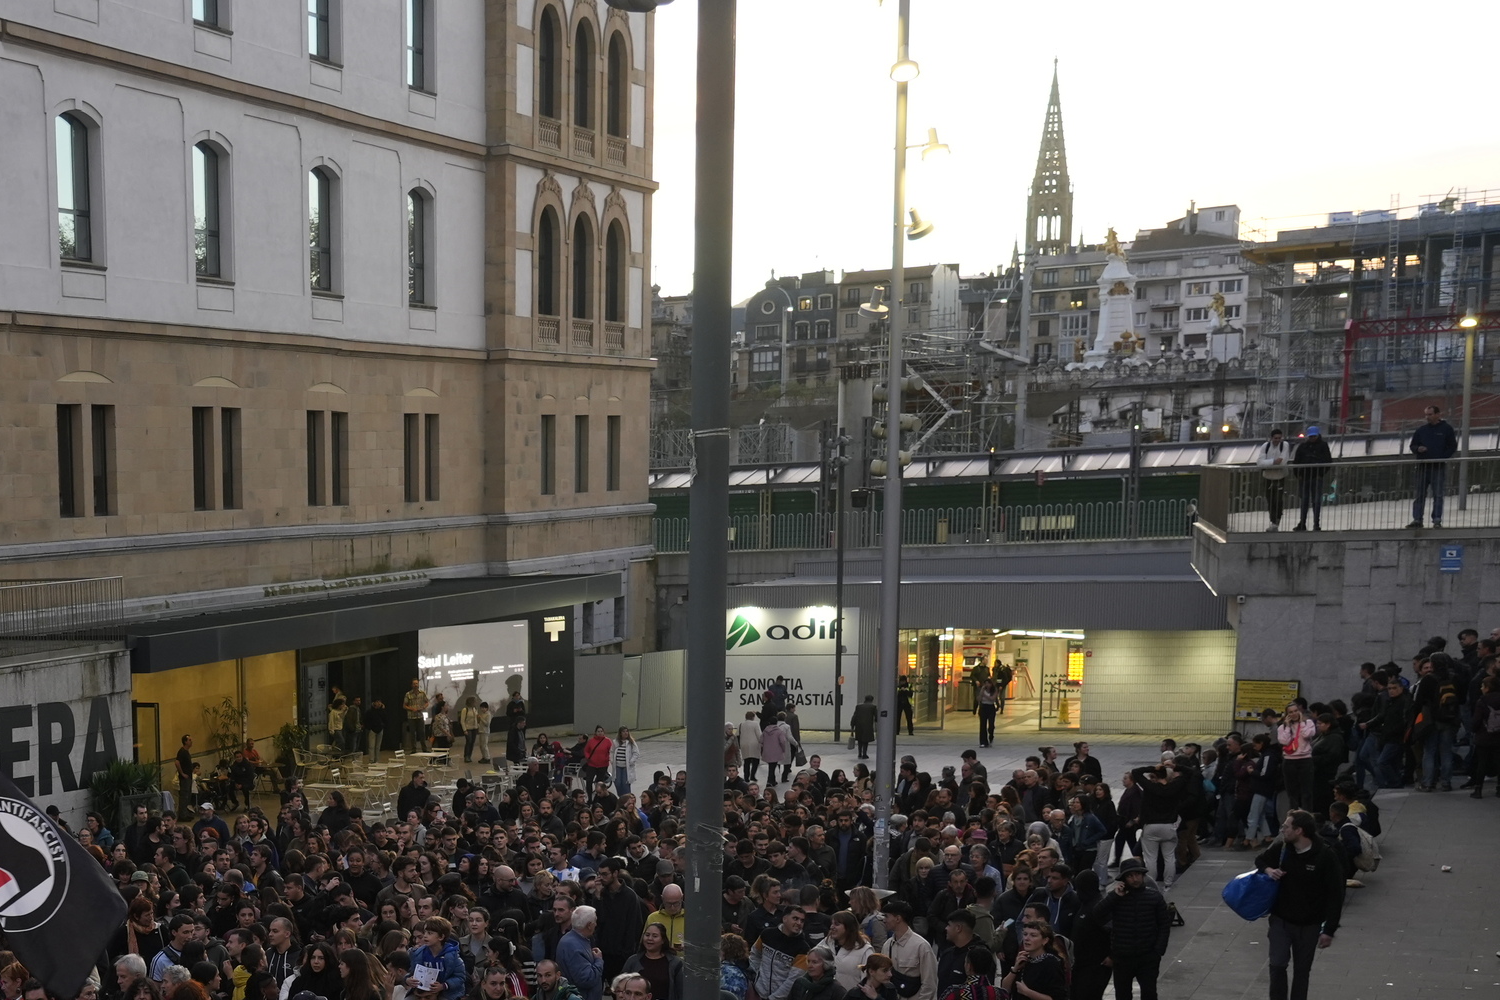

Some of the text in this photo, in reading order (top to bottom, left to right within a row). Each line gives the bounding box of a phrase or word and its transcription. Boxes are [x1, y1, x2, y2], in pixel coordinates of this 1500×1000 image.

[766, 617, 845, 640] adif
[418, 652, 474, 669] Saul Leiter
[740, 678, 803, 691] DONOTIA
